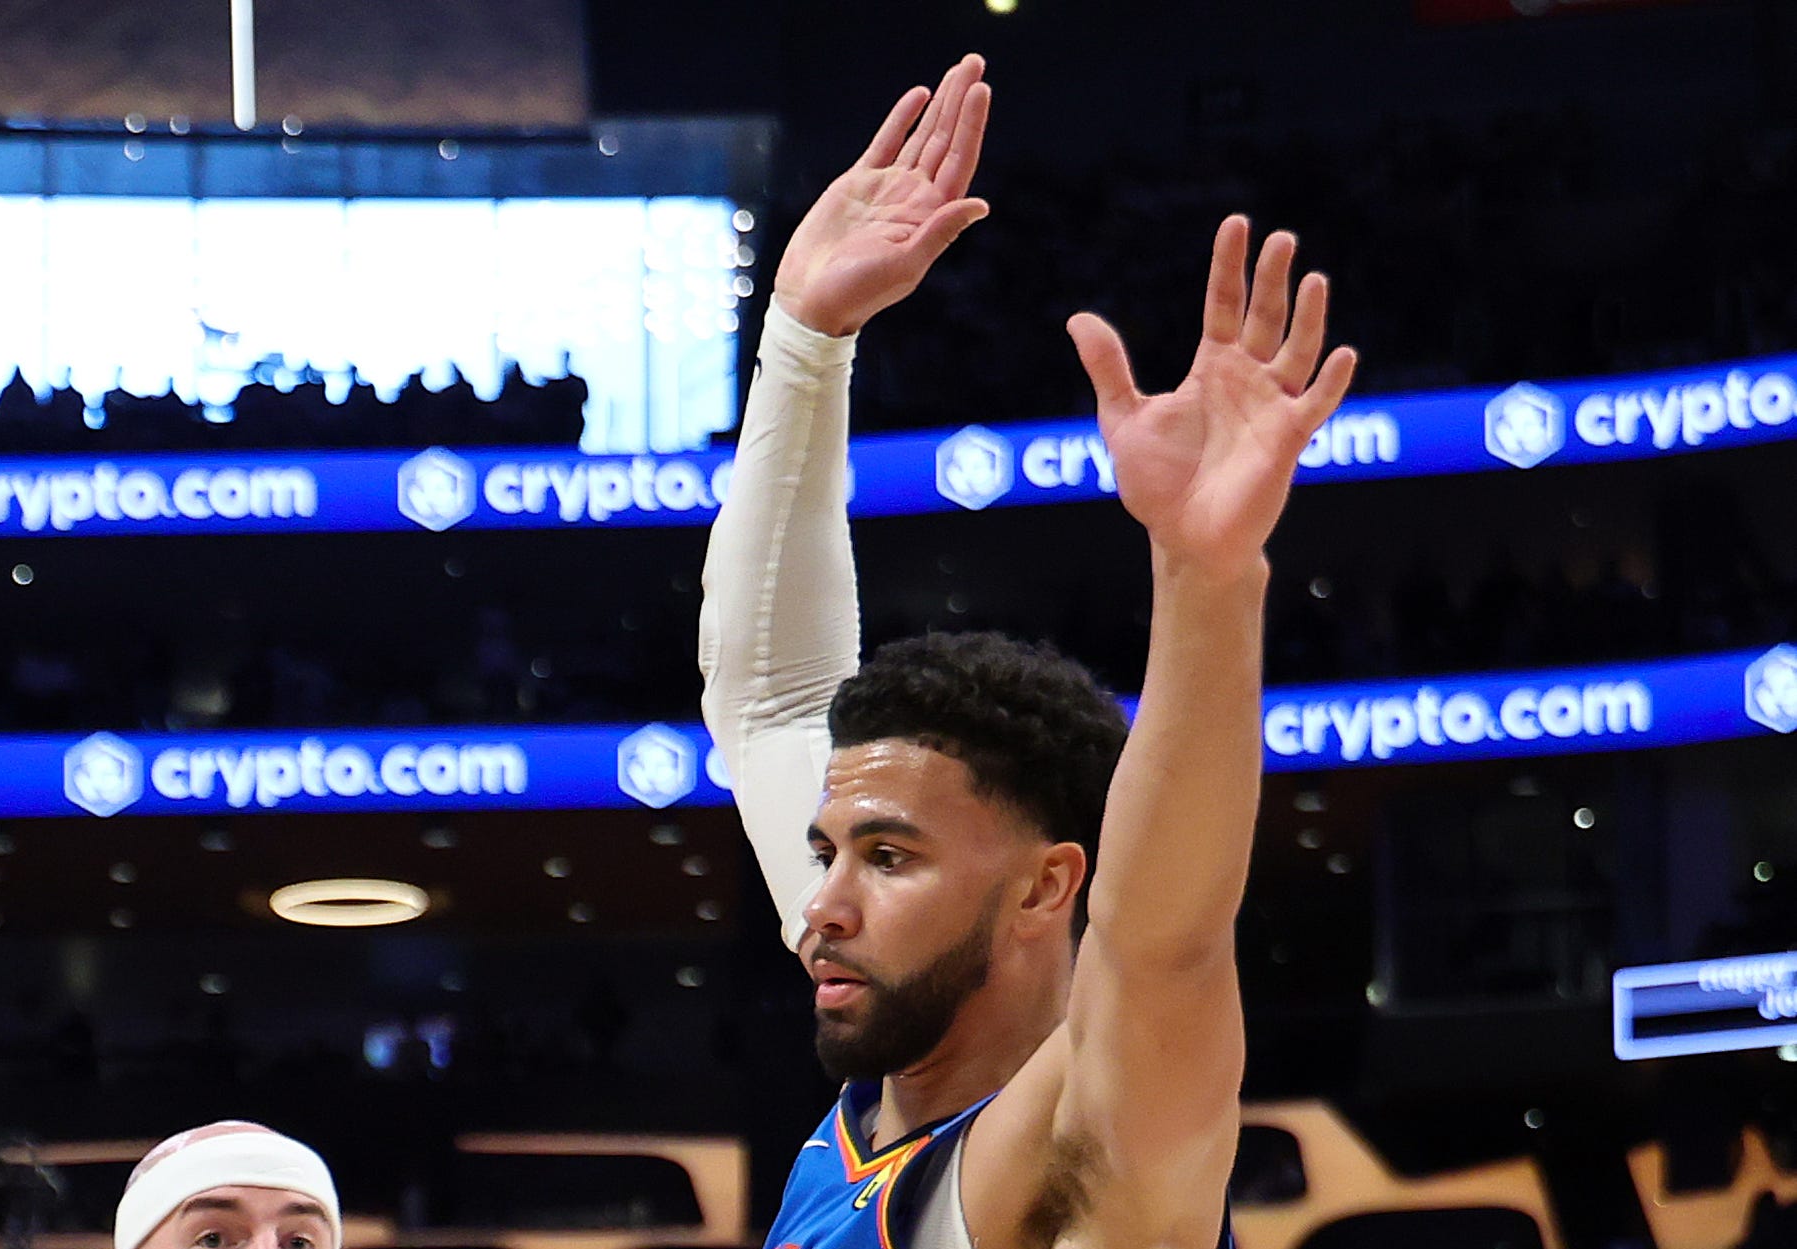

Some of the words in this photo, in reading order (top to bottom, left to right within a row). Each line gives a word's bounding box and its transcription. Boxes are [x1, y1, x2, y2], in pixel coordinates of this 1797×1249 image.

[1574, 368, 1797, 450] crypto
[483, 455, 734, 523] crypto.c
[1263, 685, 1654, 762] crypto.com
[151, 737, 528, 808] crypto.com
